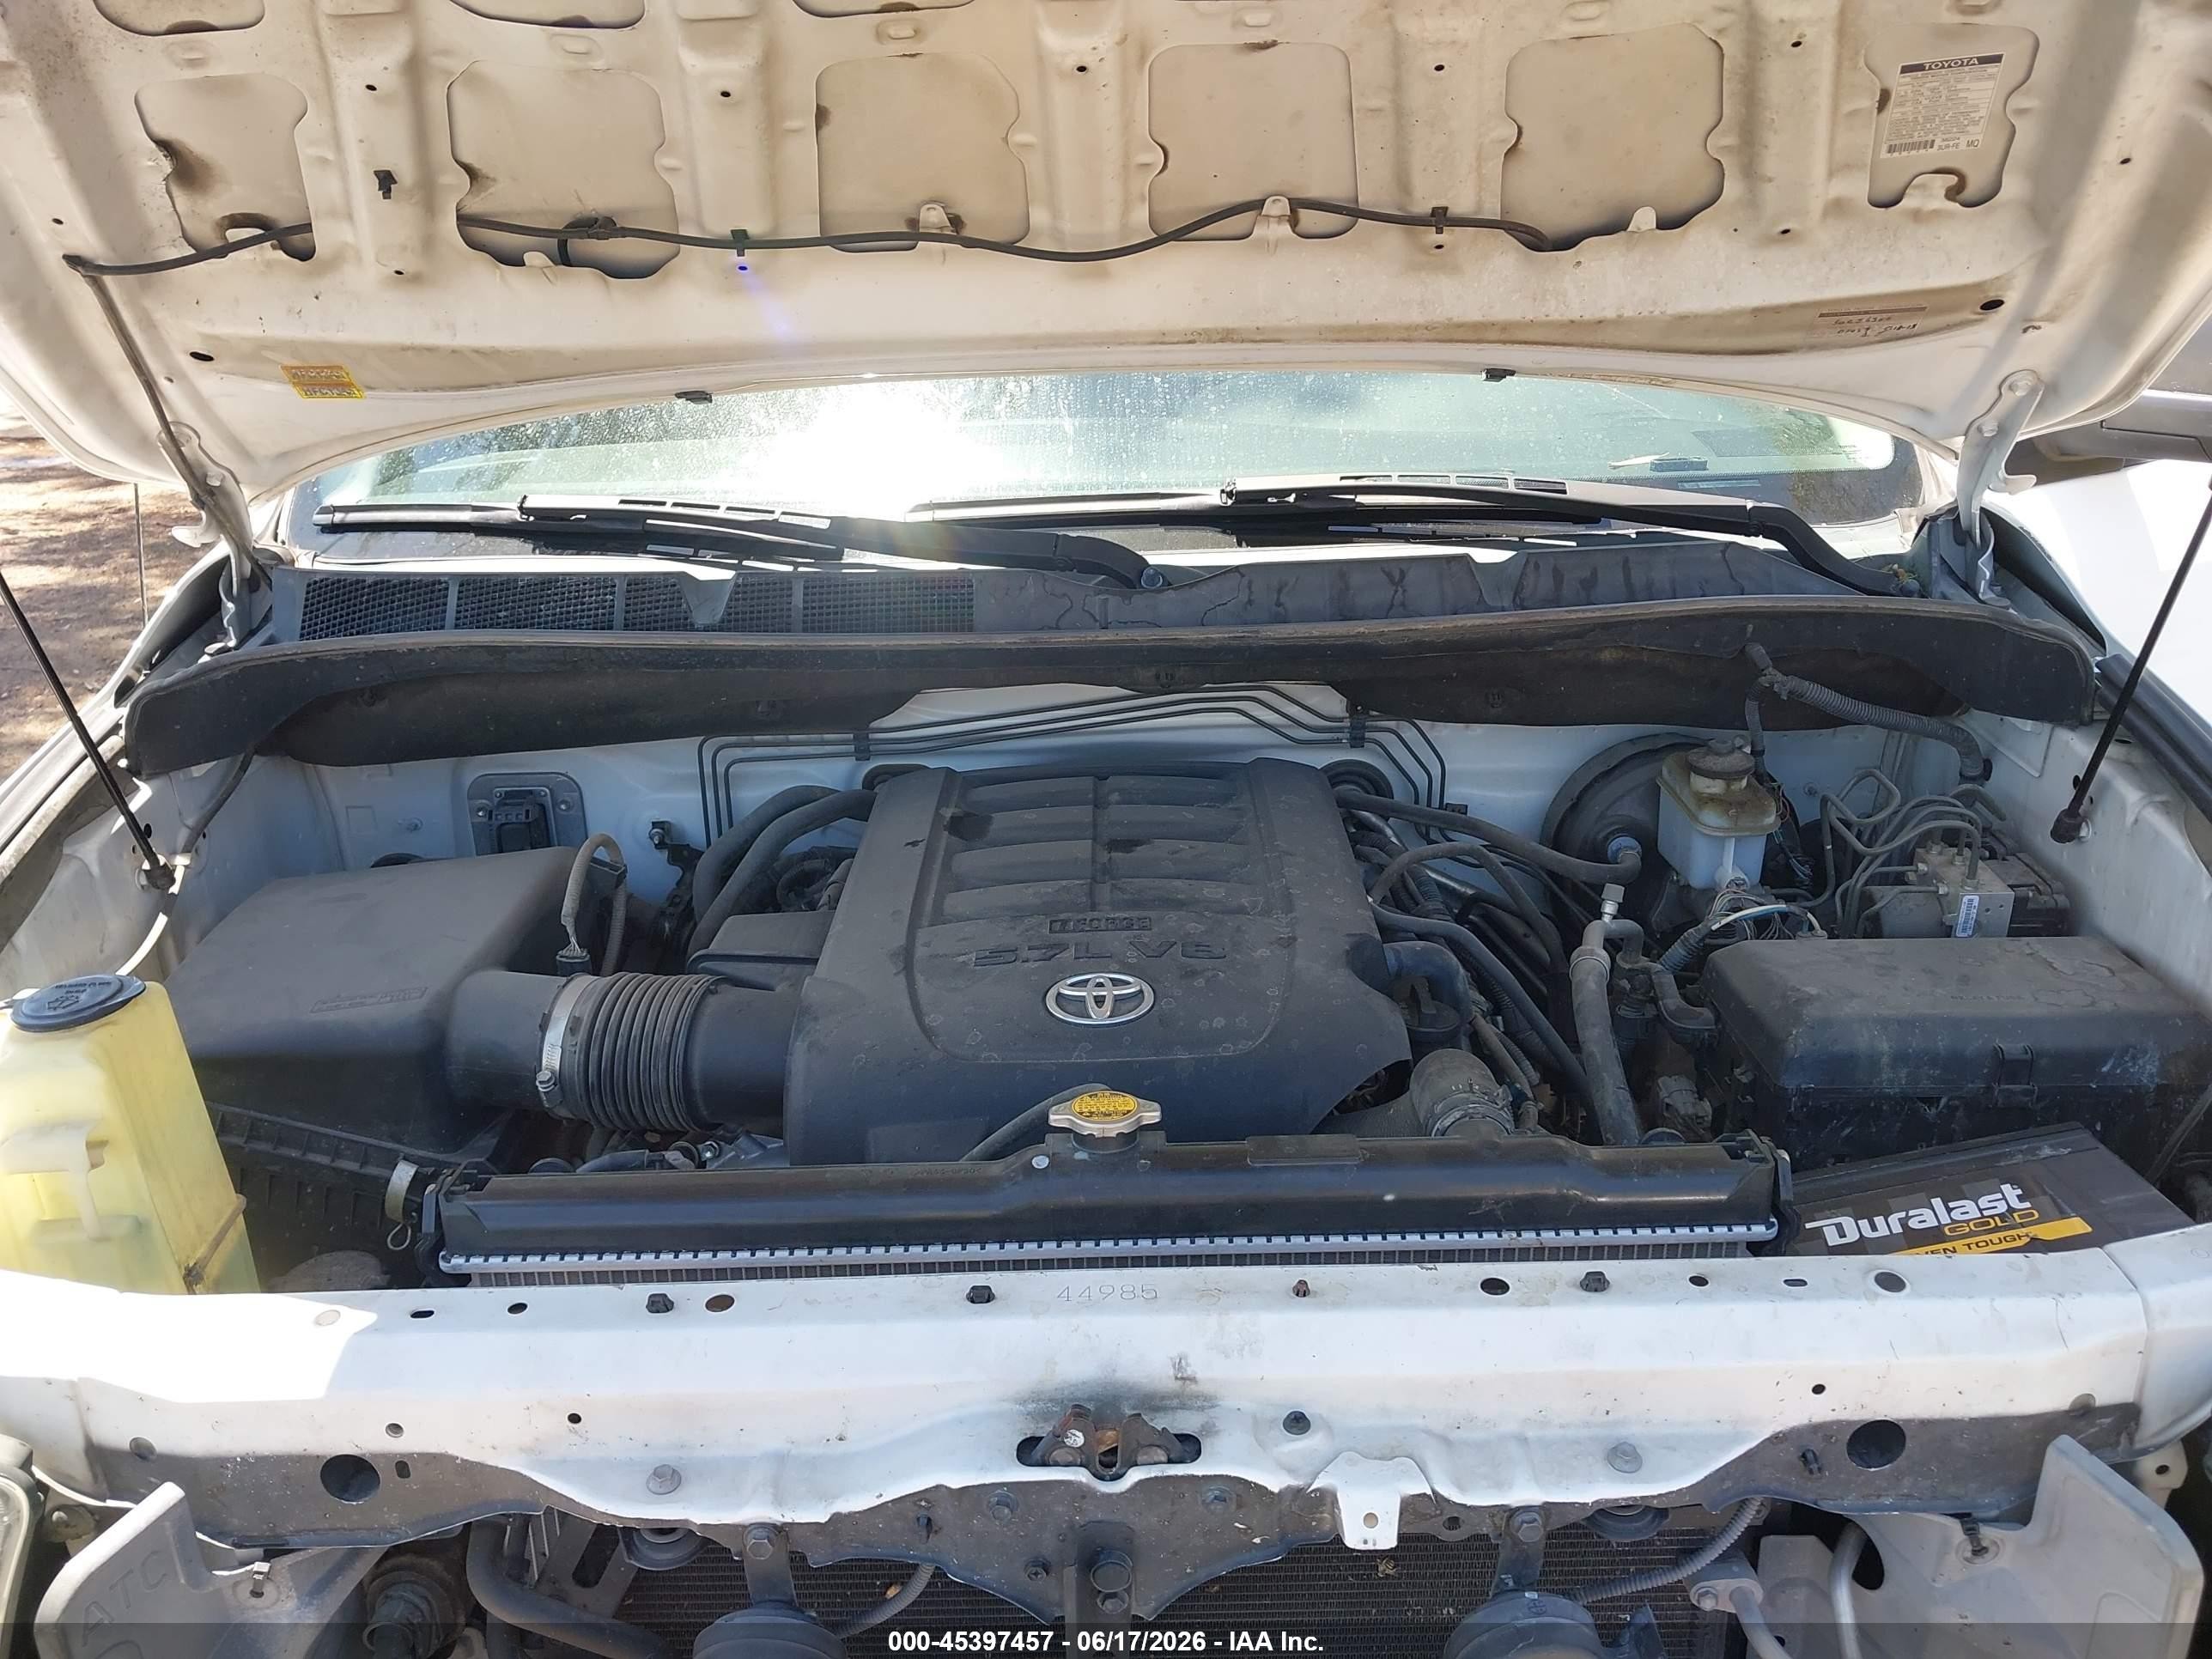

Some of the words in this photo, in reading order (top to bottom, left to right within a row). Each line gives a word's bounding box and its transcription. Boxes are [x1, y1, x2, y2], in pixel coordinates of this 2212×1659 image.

[1923, 58, 1979, 70] TOYOTA
[1805, 1182, 2033, 1246] Duralast
[1943, 1209, 2040, 1237] GOLD
[1962, 1232, 2030, 1251] TOUGH
[1057, 1284, 1158, 1302] 44985
